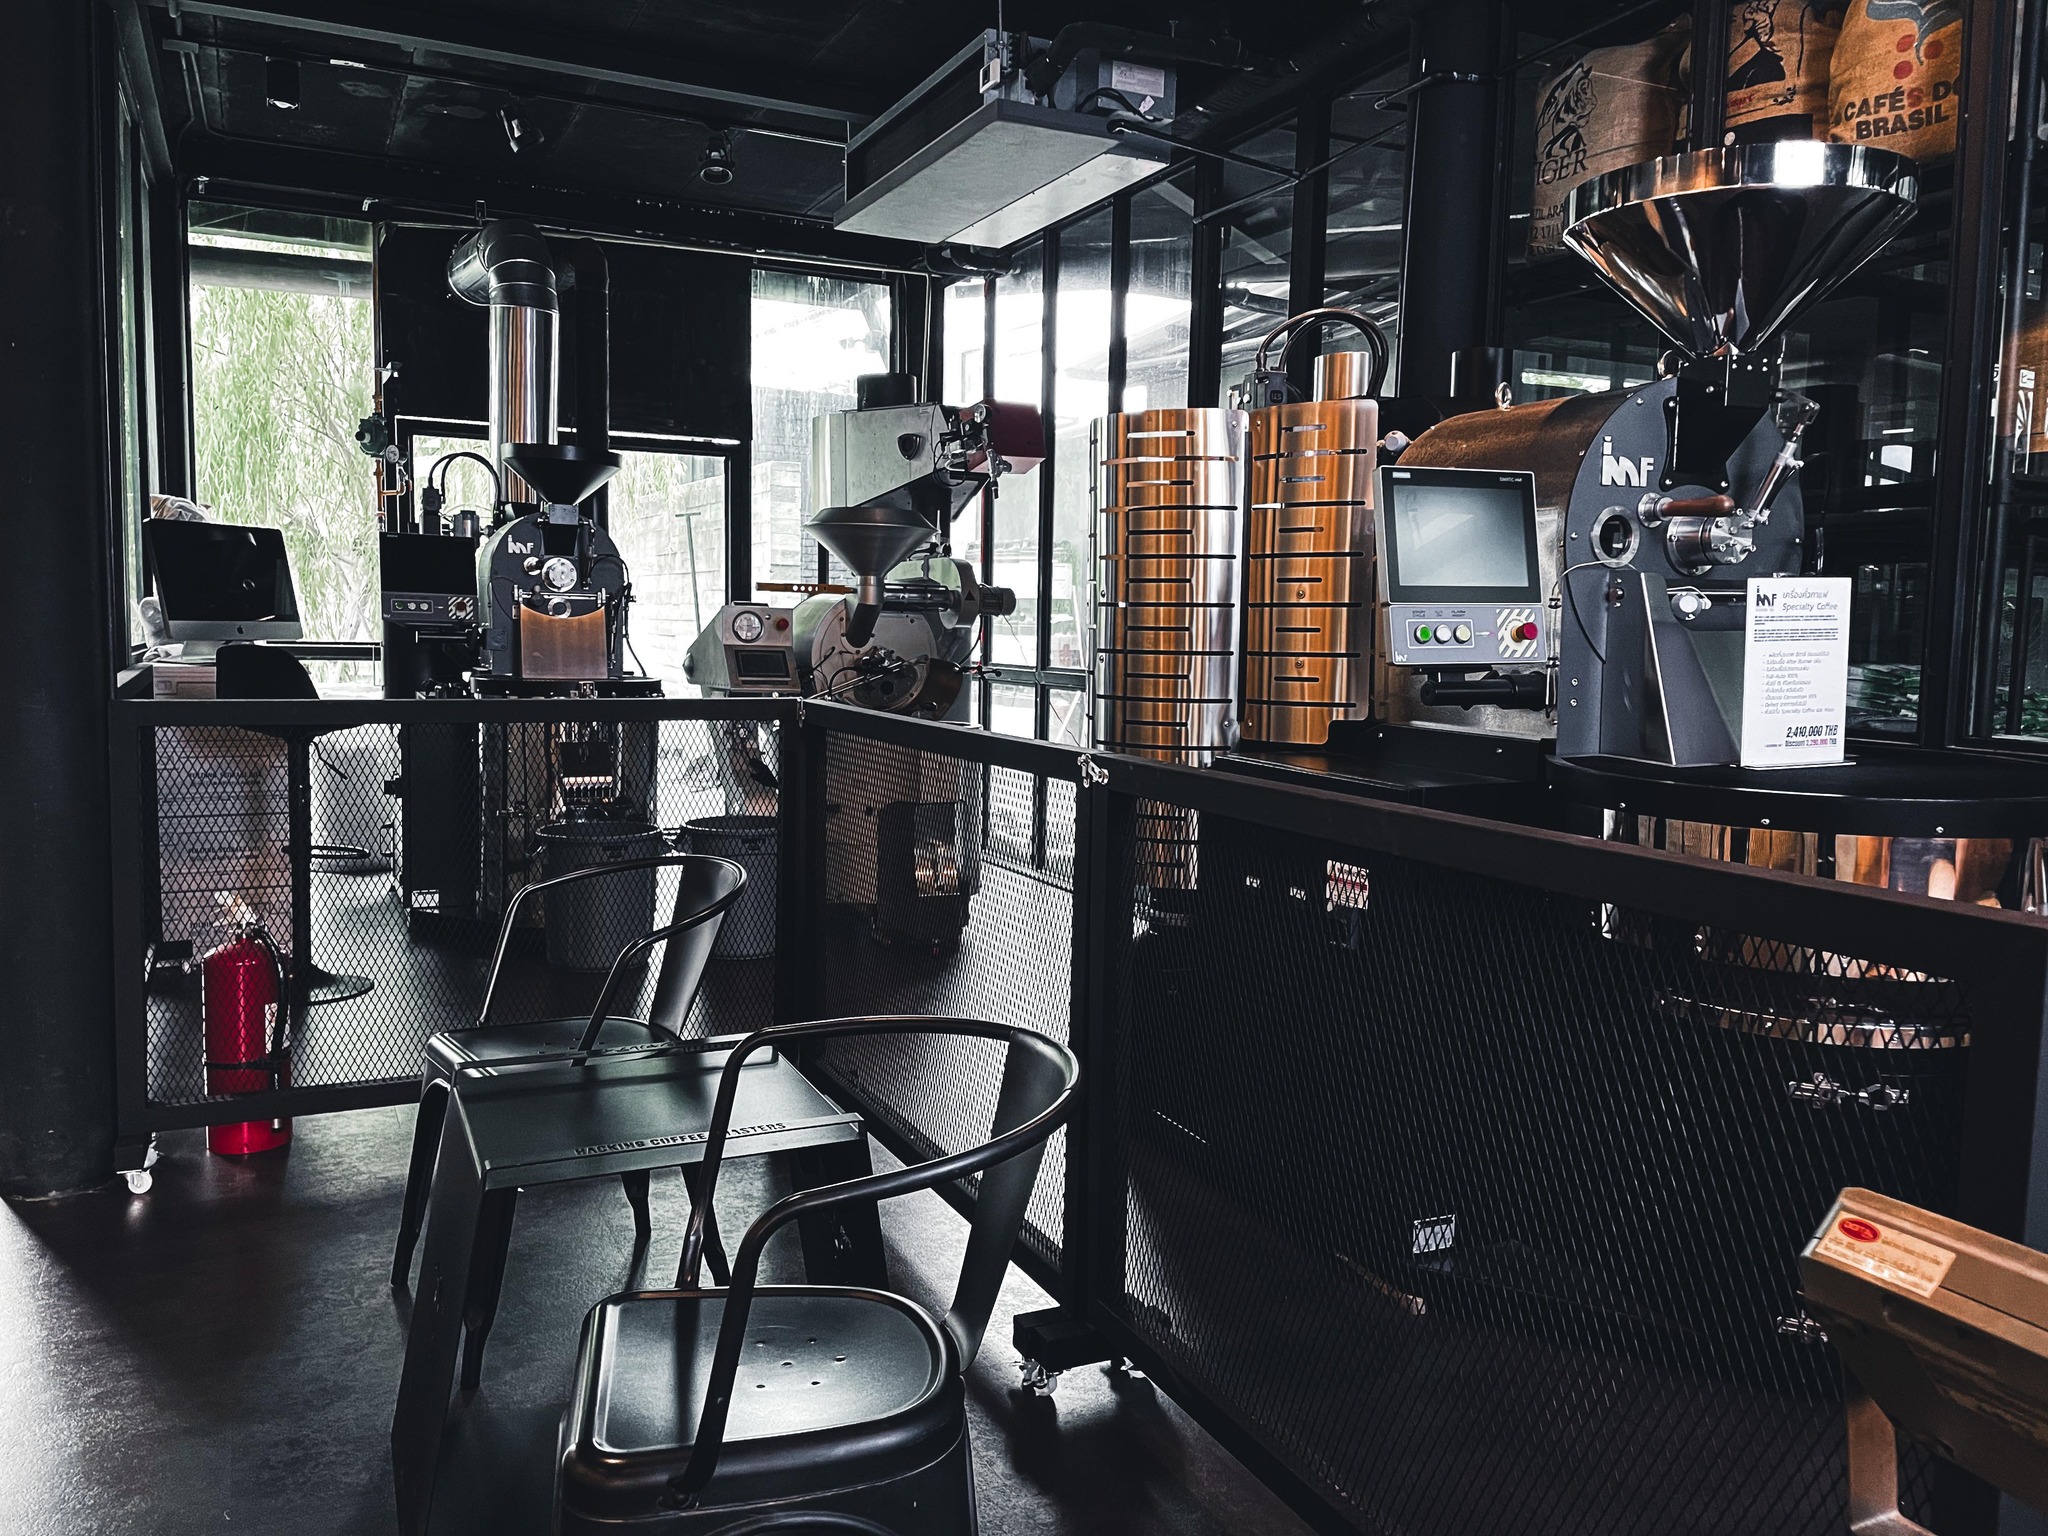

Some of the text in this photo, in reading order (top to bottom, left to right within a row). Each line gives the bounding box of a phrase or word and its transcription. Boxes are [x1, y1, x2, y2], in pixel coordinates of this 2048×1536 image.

[1844, 85, 1925, 121] CAFÉS
[1856, 103, 1950, 140] BRASIL
[1535, 147, 1588, 187] IGER
[1782, 602, 1815, 612] Specialty
[1816, 602, 1838, 610] Coffee
[1786, 724, 1839, 738] 2,410,000 THB
[649, 1132, 707, 1147] COFFEE
